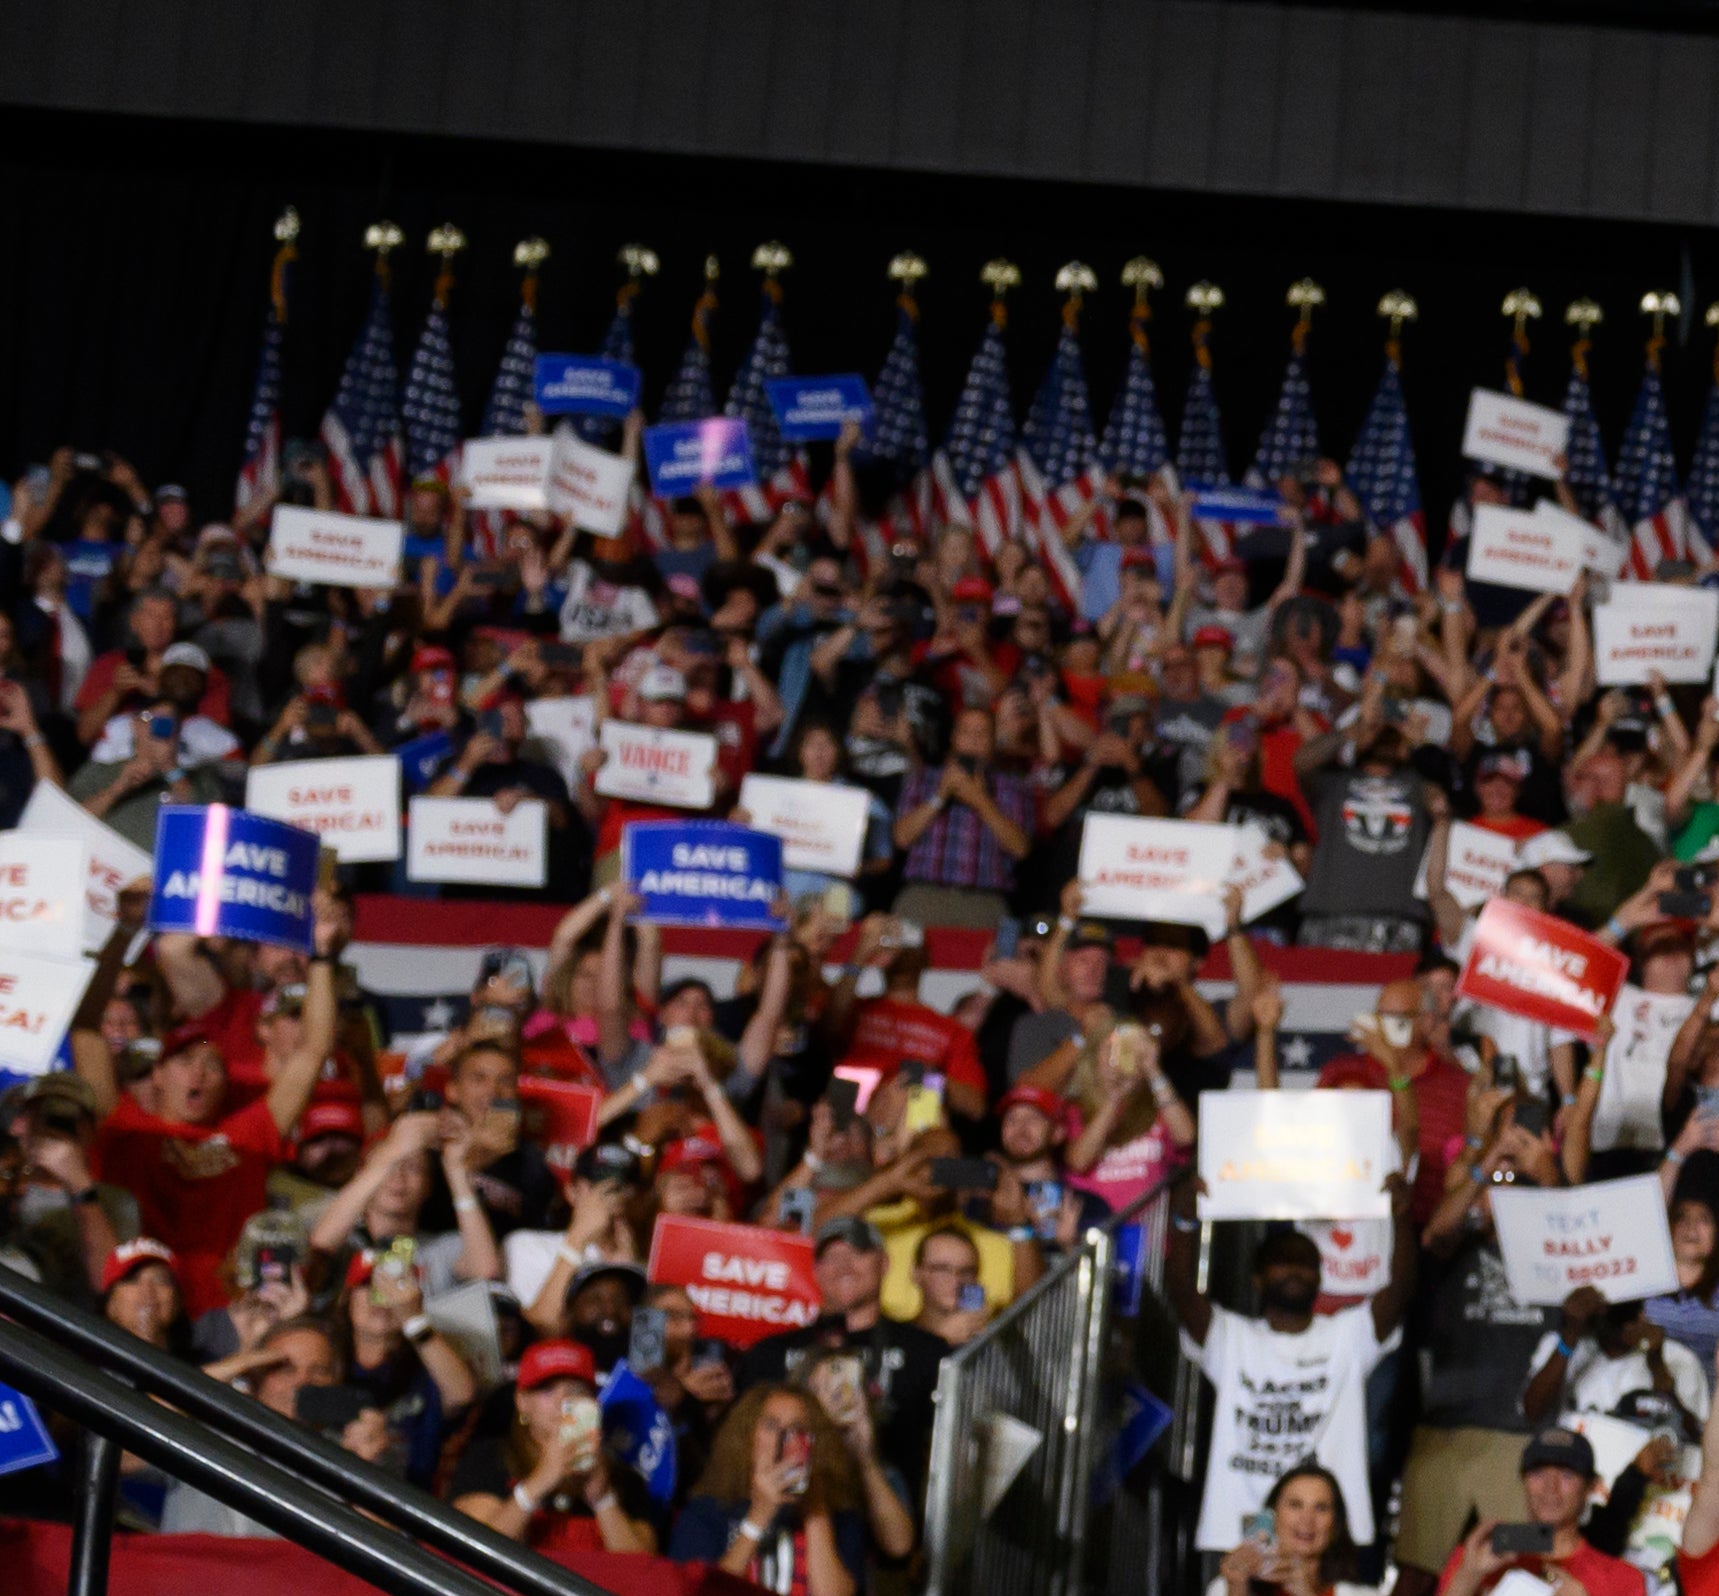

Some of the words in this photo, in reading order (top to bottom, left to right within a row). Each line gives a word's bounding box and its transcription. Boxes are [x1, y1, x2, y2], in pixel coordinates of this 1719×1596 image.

[619, 738, 691, 778] VANCE
[287, 784, 353, 806] SAVE
[672, 843, 749, 880] SAVE
[639, 871, 775, 923] AMERICA!
[1541, 1234, 1613, 1258] RALLY
[702, 1251, 790, 1291] SAVE
[685, 1282, 820, 1327] MERICA!
